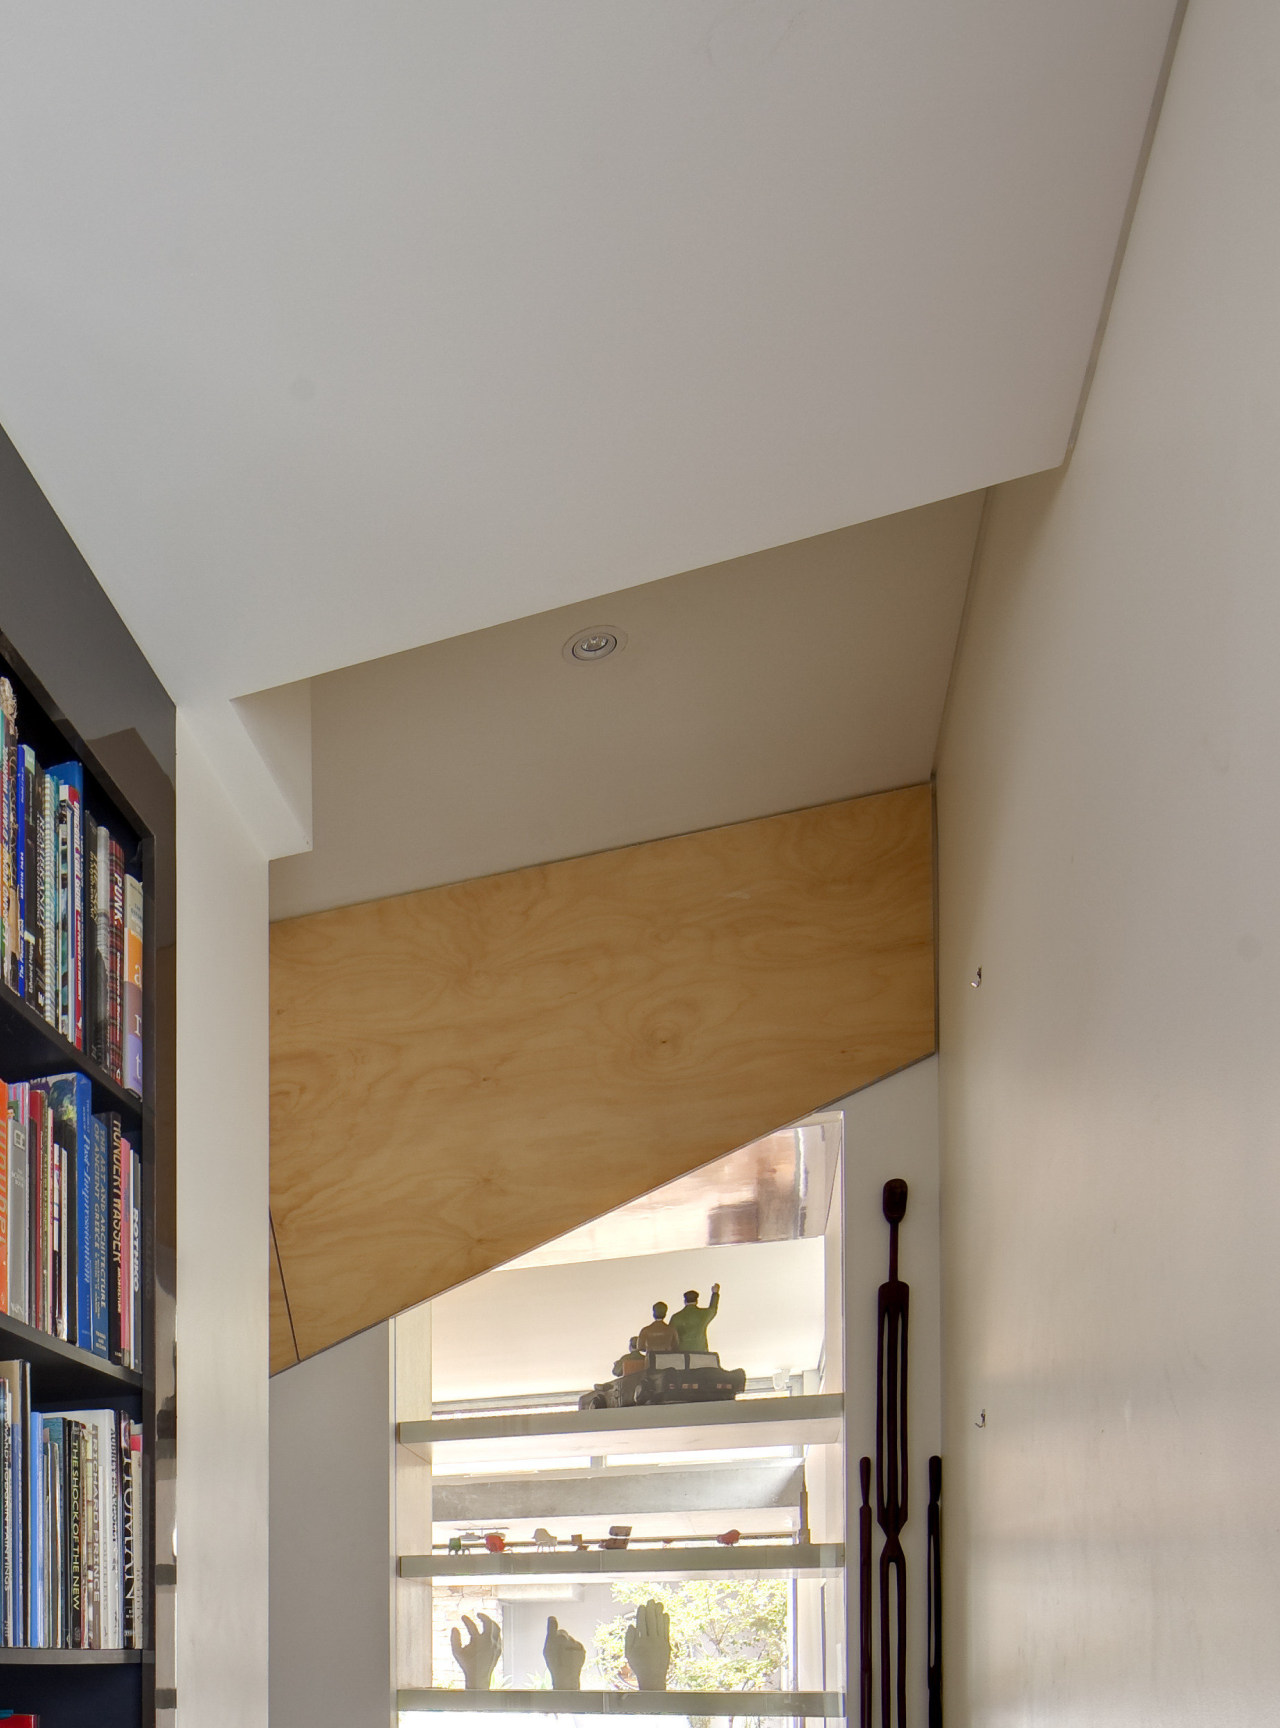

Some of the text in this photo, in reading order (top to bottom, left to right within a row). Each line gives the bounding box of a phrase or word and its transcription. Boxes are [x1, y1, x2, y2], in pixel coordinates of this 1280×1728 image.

[81, 1132, 91, 1285] Post-Impressionism
[71, 1439, 79, 1611] THE SHOCK OF THE NEW
